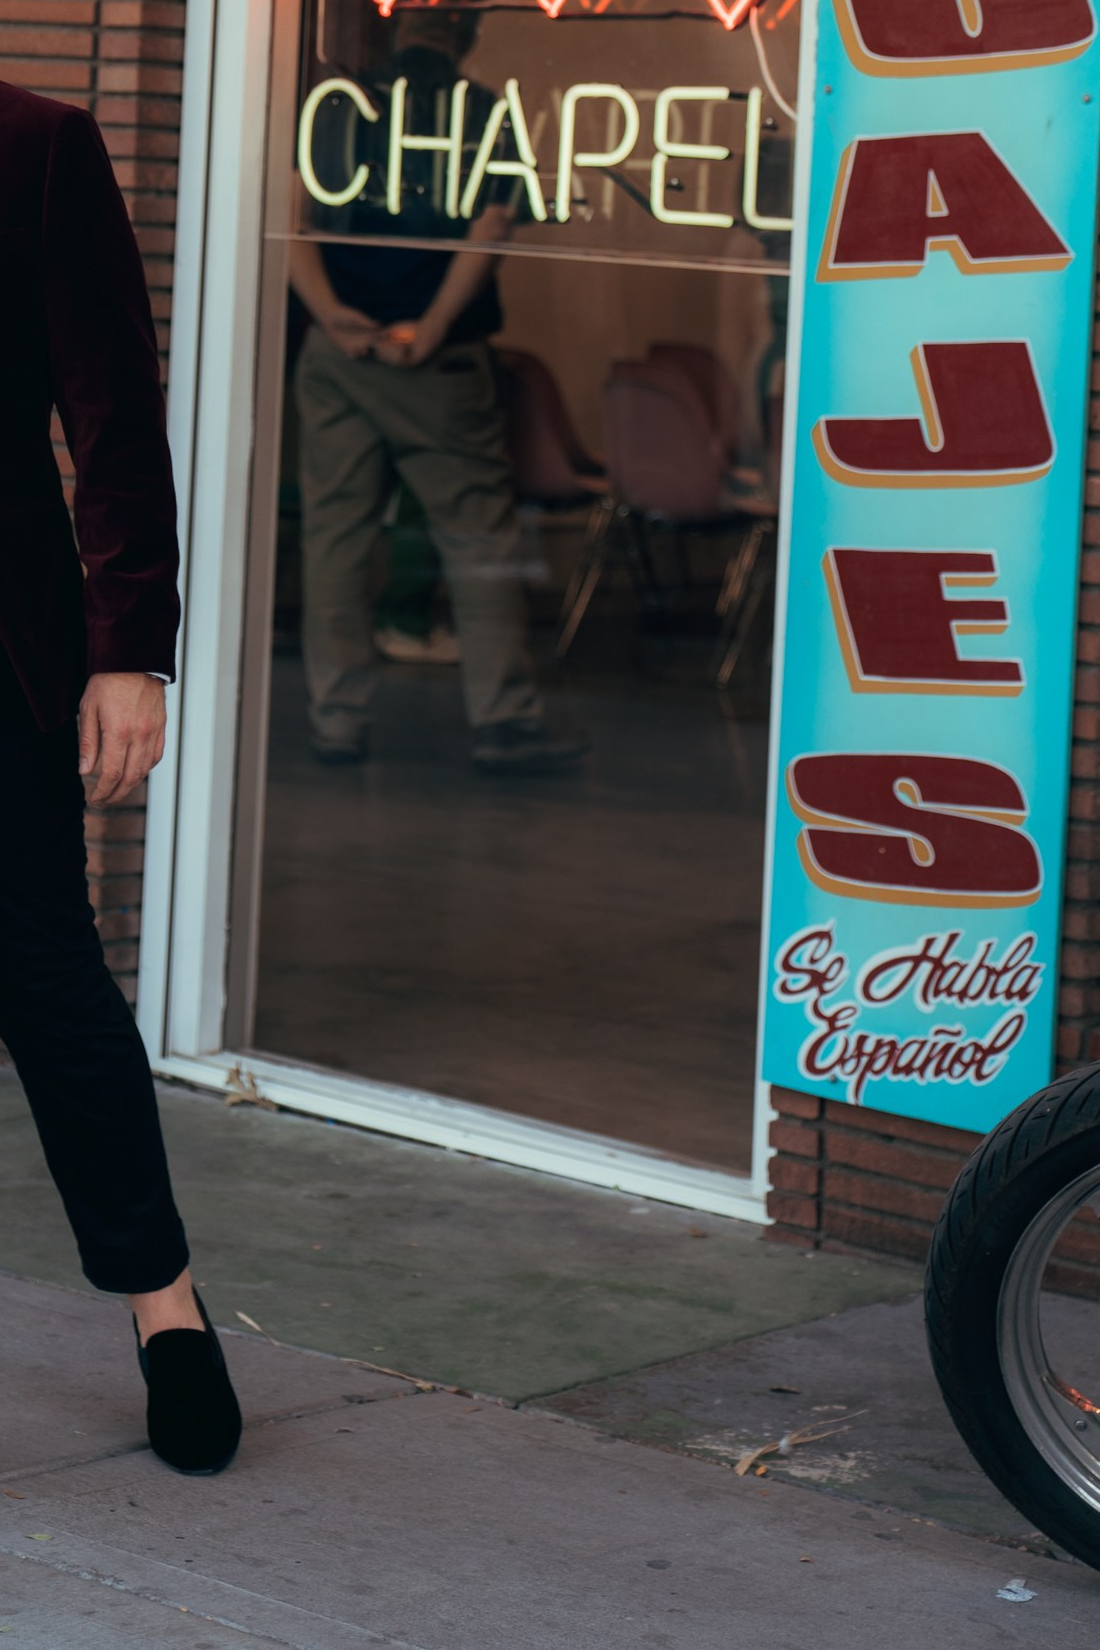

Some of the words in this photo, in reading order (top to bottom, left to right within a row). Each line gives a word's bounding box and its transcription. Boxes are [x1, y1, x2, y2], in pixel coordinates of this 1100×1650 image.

[299, 78, 796, 232] CHAPEL
[775, 921, 847, 1001] Se
[857, 929, 1045, 1009] Habla
[800, 1002, 1026, 1105] Español
